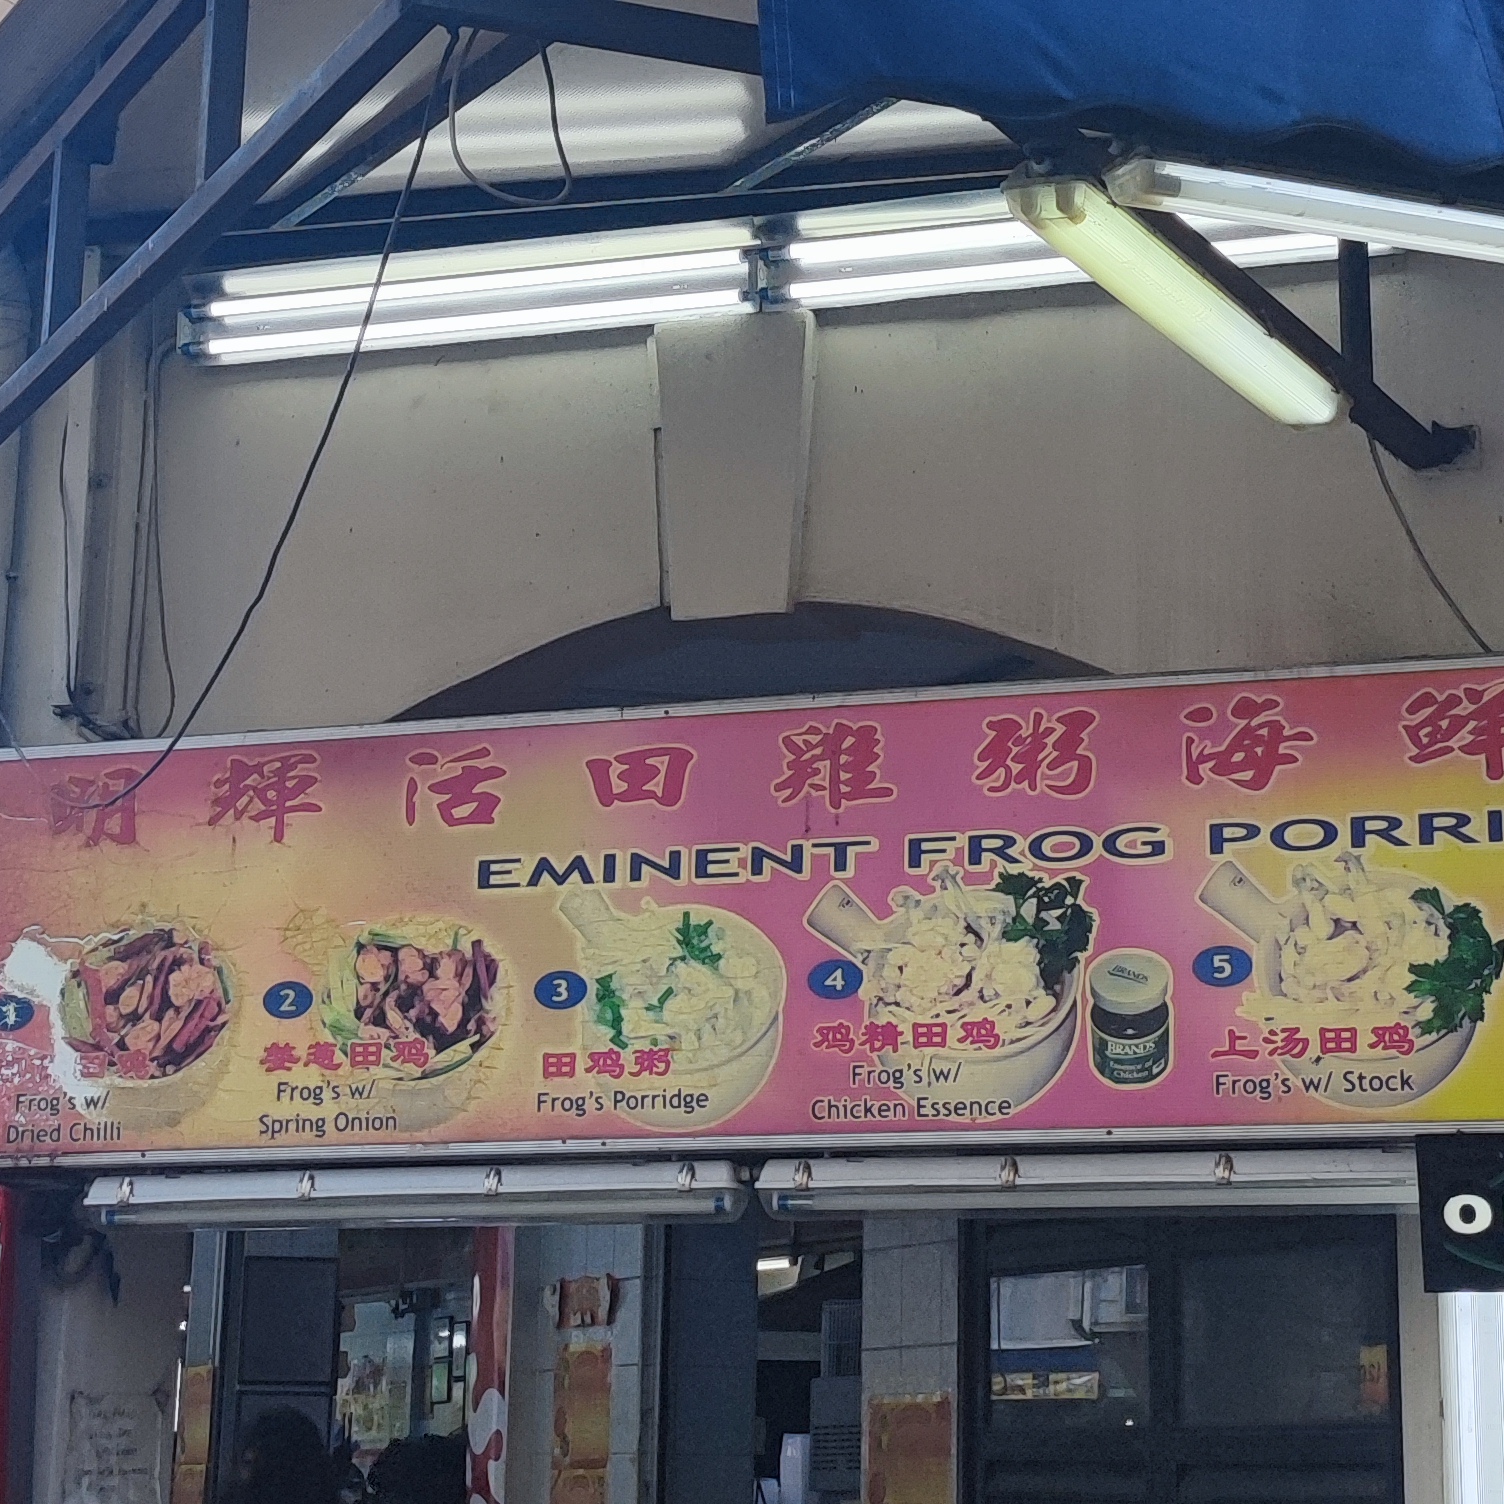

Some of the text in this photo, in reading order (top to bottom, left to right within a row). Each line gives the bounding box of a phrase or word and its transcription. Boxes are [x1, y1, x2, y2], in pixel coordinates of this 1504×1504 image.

[476, 836, 875, 891] EMINENT
[906, 825, 1169, 870] FROG
[823, 968, 846, 990] 4
[1213, 955, 1233, 979] 5
[278, 989, 297, 1012] 2
[550, 978, 570, 1002] 3
[812, 1017, 1002, 1054] 鸡精田鸡
[1209, 1022, 1416, 1060] 上汤田鸡
[542, 1047, 672, 1080] 田鸡粥
[850, 1061, 964, 1091] Frog's w/
[276, 1079, 378, 1103] Frog's w/
[1214, 1068, 1415, 1100] Frog's w/ Stock
[14, 1090, 111, 1115] Frog's w/
[536, 1088, 710, 1118] Frog's Porridge
[810, 1096, 1013, 1120] Chicken Essence
[5, 1120, 123, 1145] Dried Chilli
[258, 1111, 398, 1138] Spring Onion
